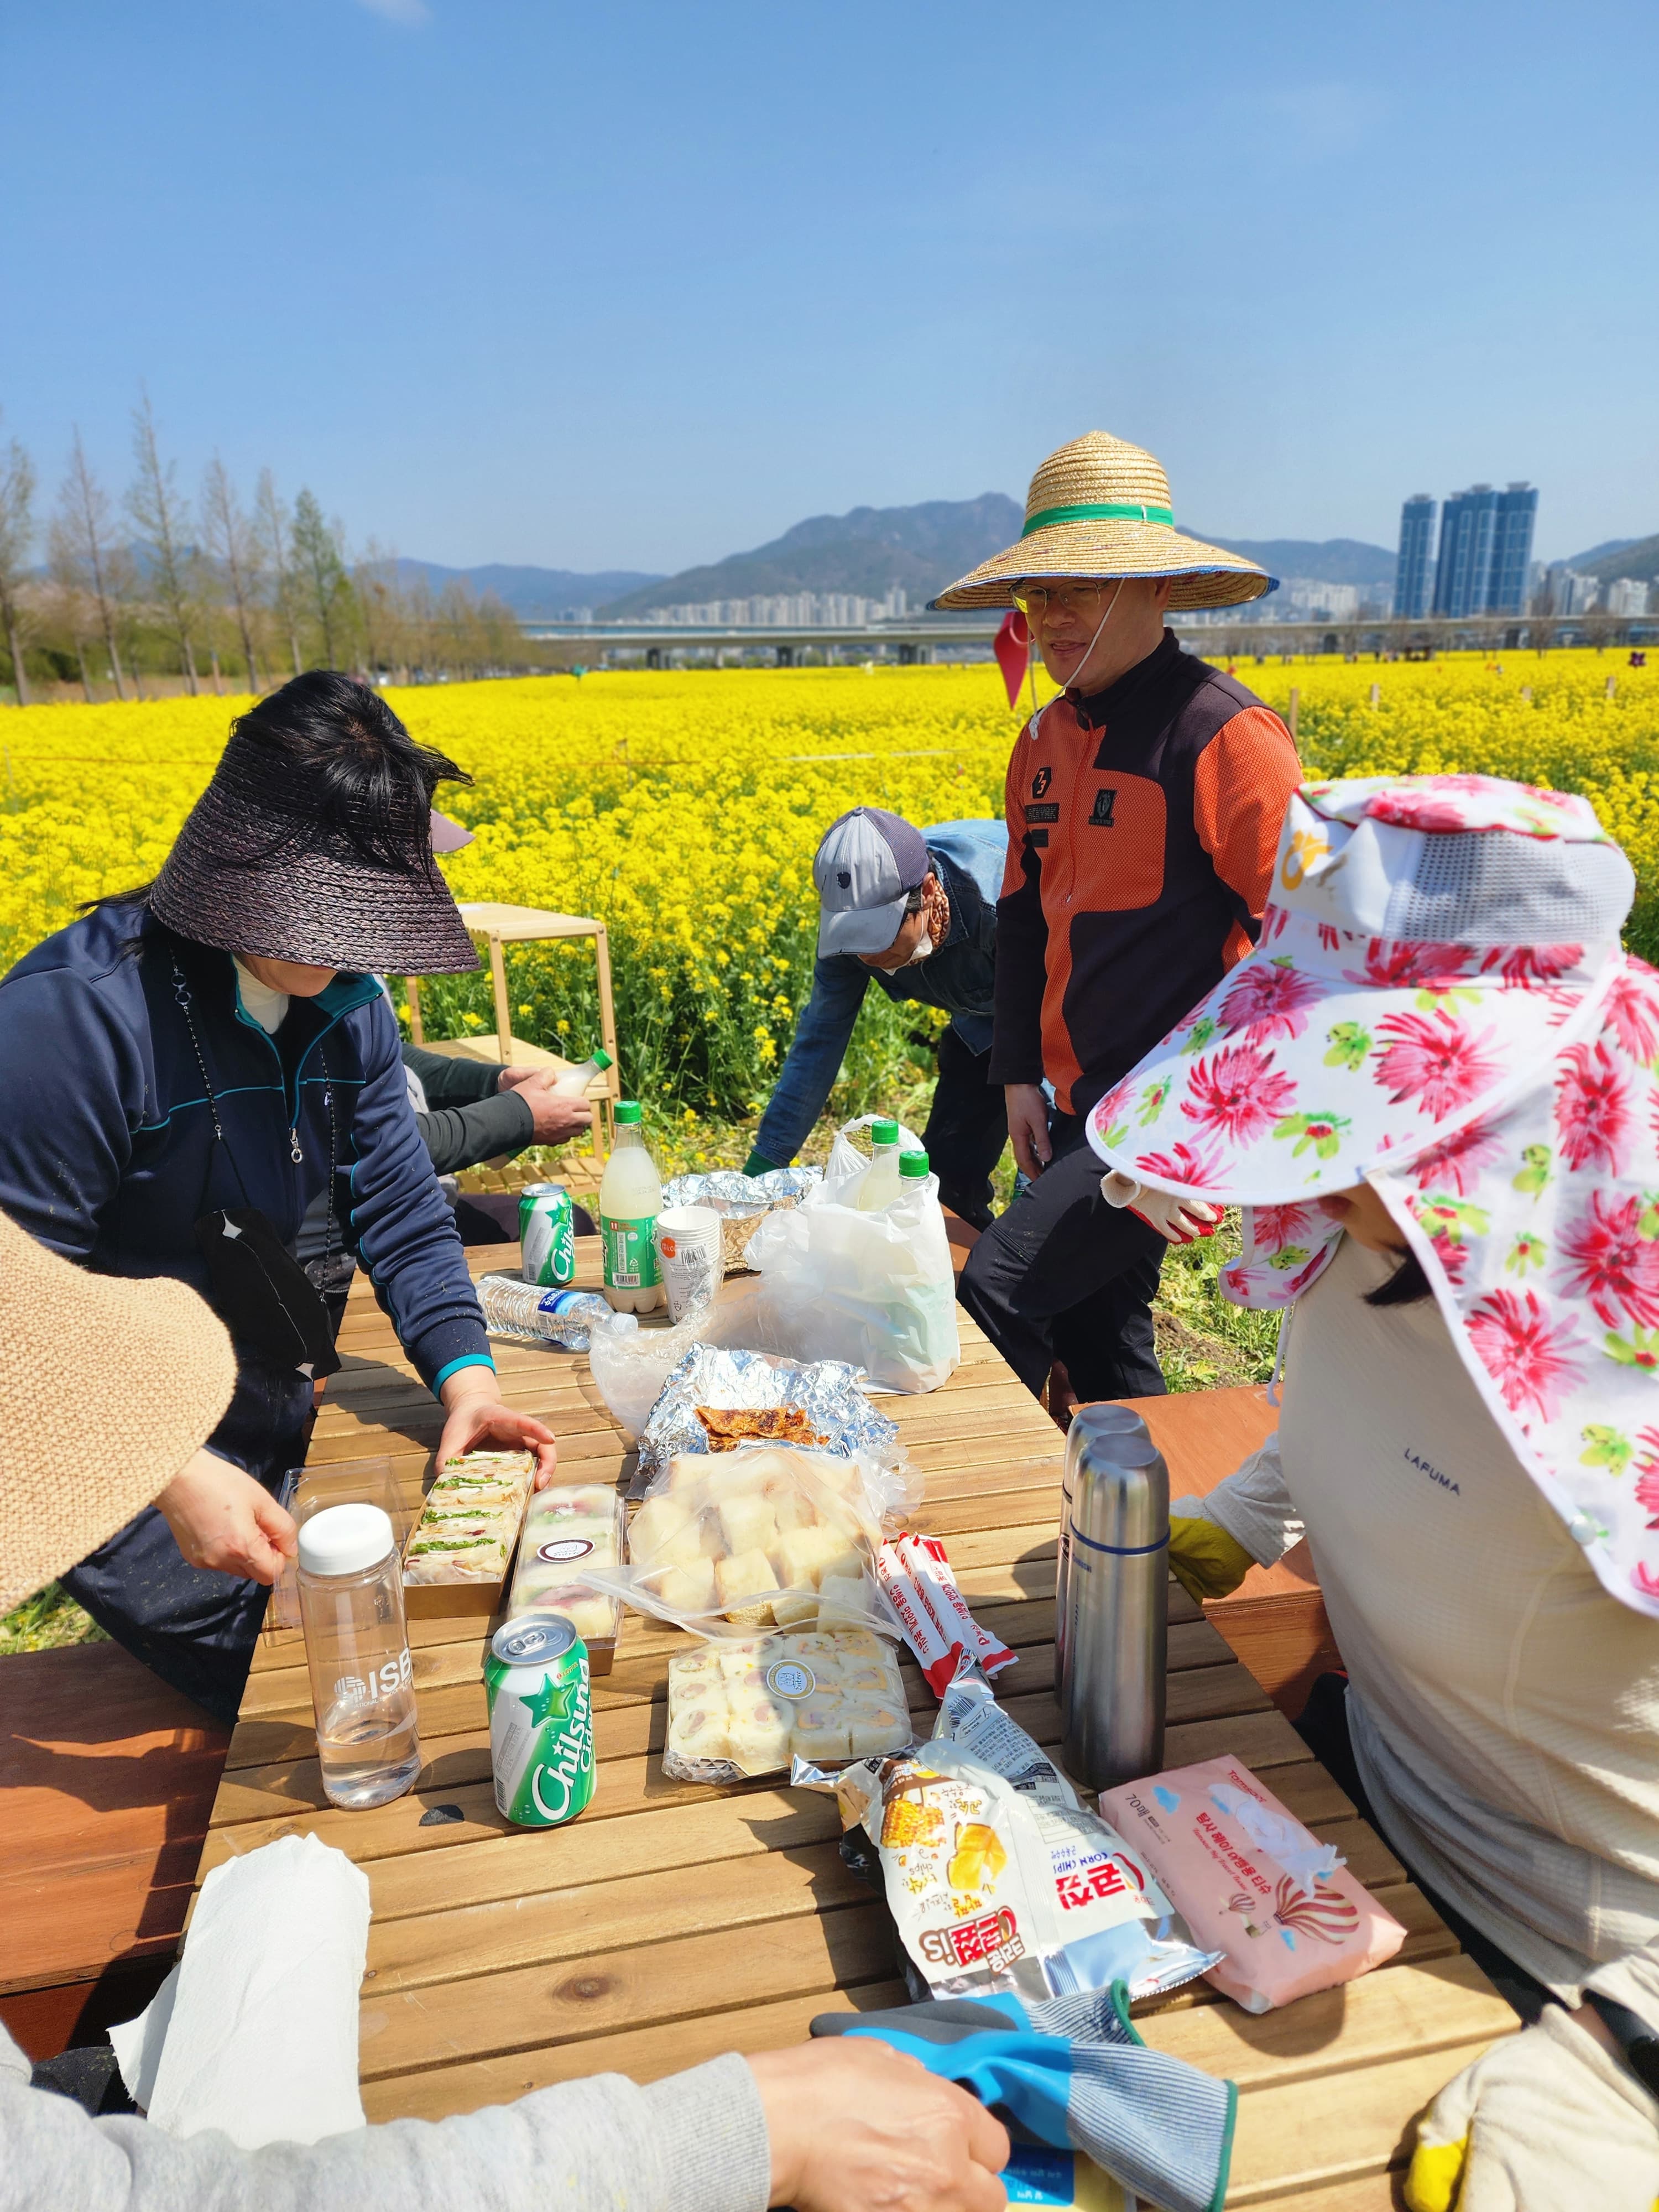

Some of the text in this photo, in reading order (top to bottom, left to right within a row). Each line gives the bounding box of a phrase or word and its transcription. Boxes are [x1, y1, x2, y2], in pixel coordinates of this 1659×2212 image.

[1404, 1448, 1460, 1496] LAFUMA
[369, 1647, 411, 1700] ISB
[1125, 1793, 1150, 1818] 70매
[909, 1862, 933, 1877] chips
[1053, 1851, 1108, 1875] CORN CHIPS
[1251, 1875, 1272, 1895] 티슈
[988, 1939, 1024, 1973] 크라운
